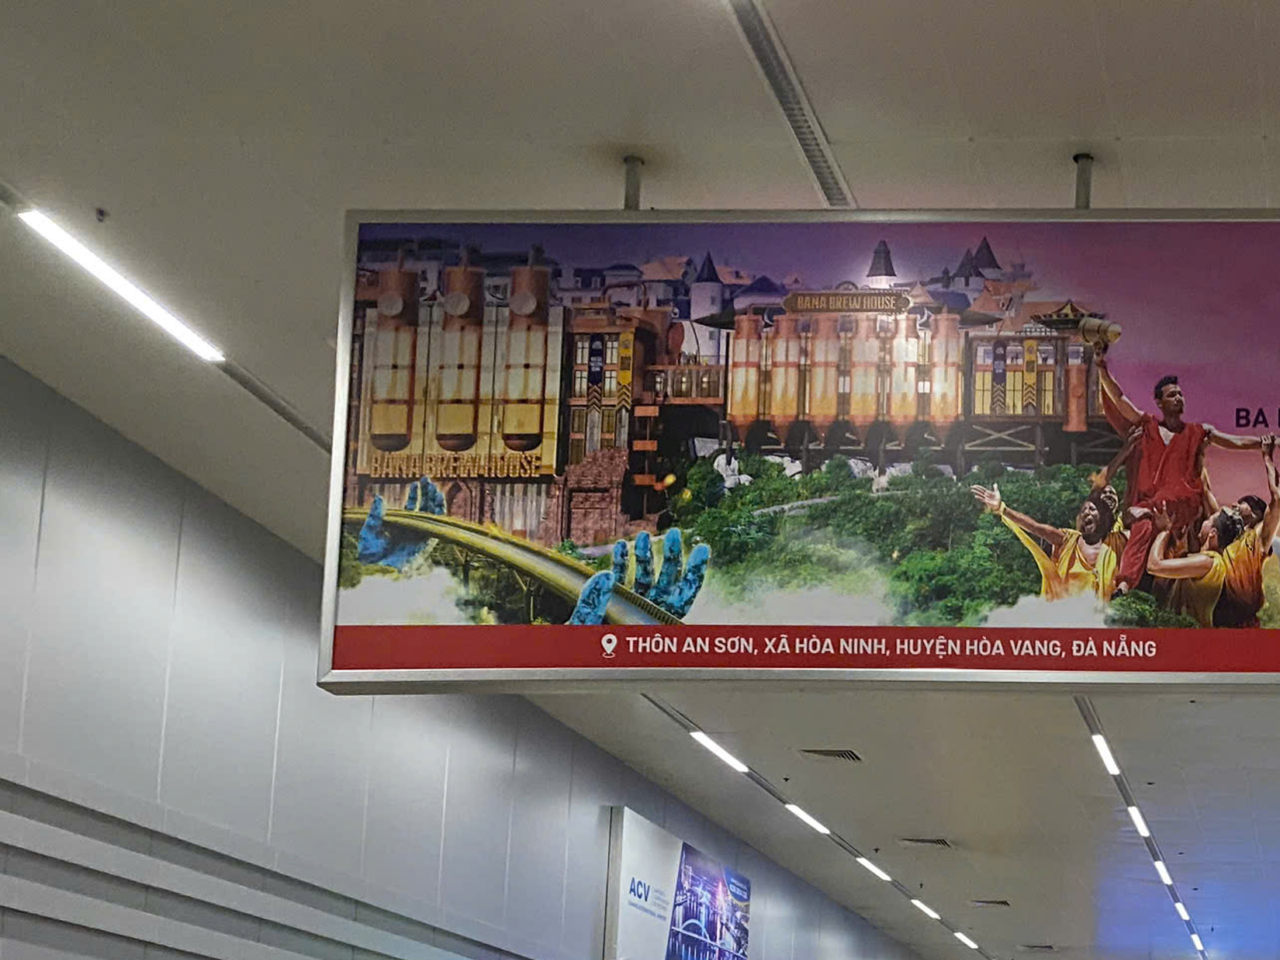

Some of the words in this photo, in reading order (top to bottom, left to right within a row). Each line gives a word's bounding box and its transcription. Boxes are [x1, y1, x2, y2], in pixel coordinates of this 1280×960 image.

[863, 296, 896, 309] HOUSE
[1235, 407, 1269, 428] BA
[484, 453, 541, 478] HOUSE
[626, 633, 677, 653] THÔN
[682, 637, 709, 653] AN
[714, 636, 758, 655] SƠN,
[764, 634, 789, 654] XÃ
[795, 634, 835, 654] HÒA
[840, 637, 890, 656] NINH,
[896, 635, 961, 659] HUYỆN
[965, 636, 1005, 656] HÒA
[1010, 639, 1065, 658] VANG,
[1072, 637, 1097, 657] ĐÀ
[1103, 634, 1157, 657] NẴNG
[629, 877, 650, 902] ACV
